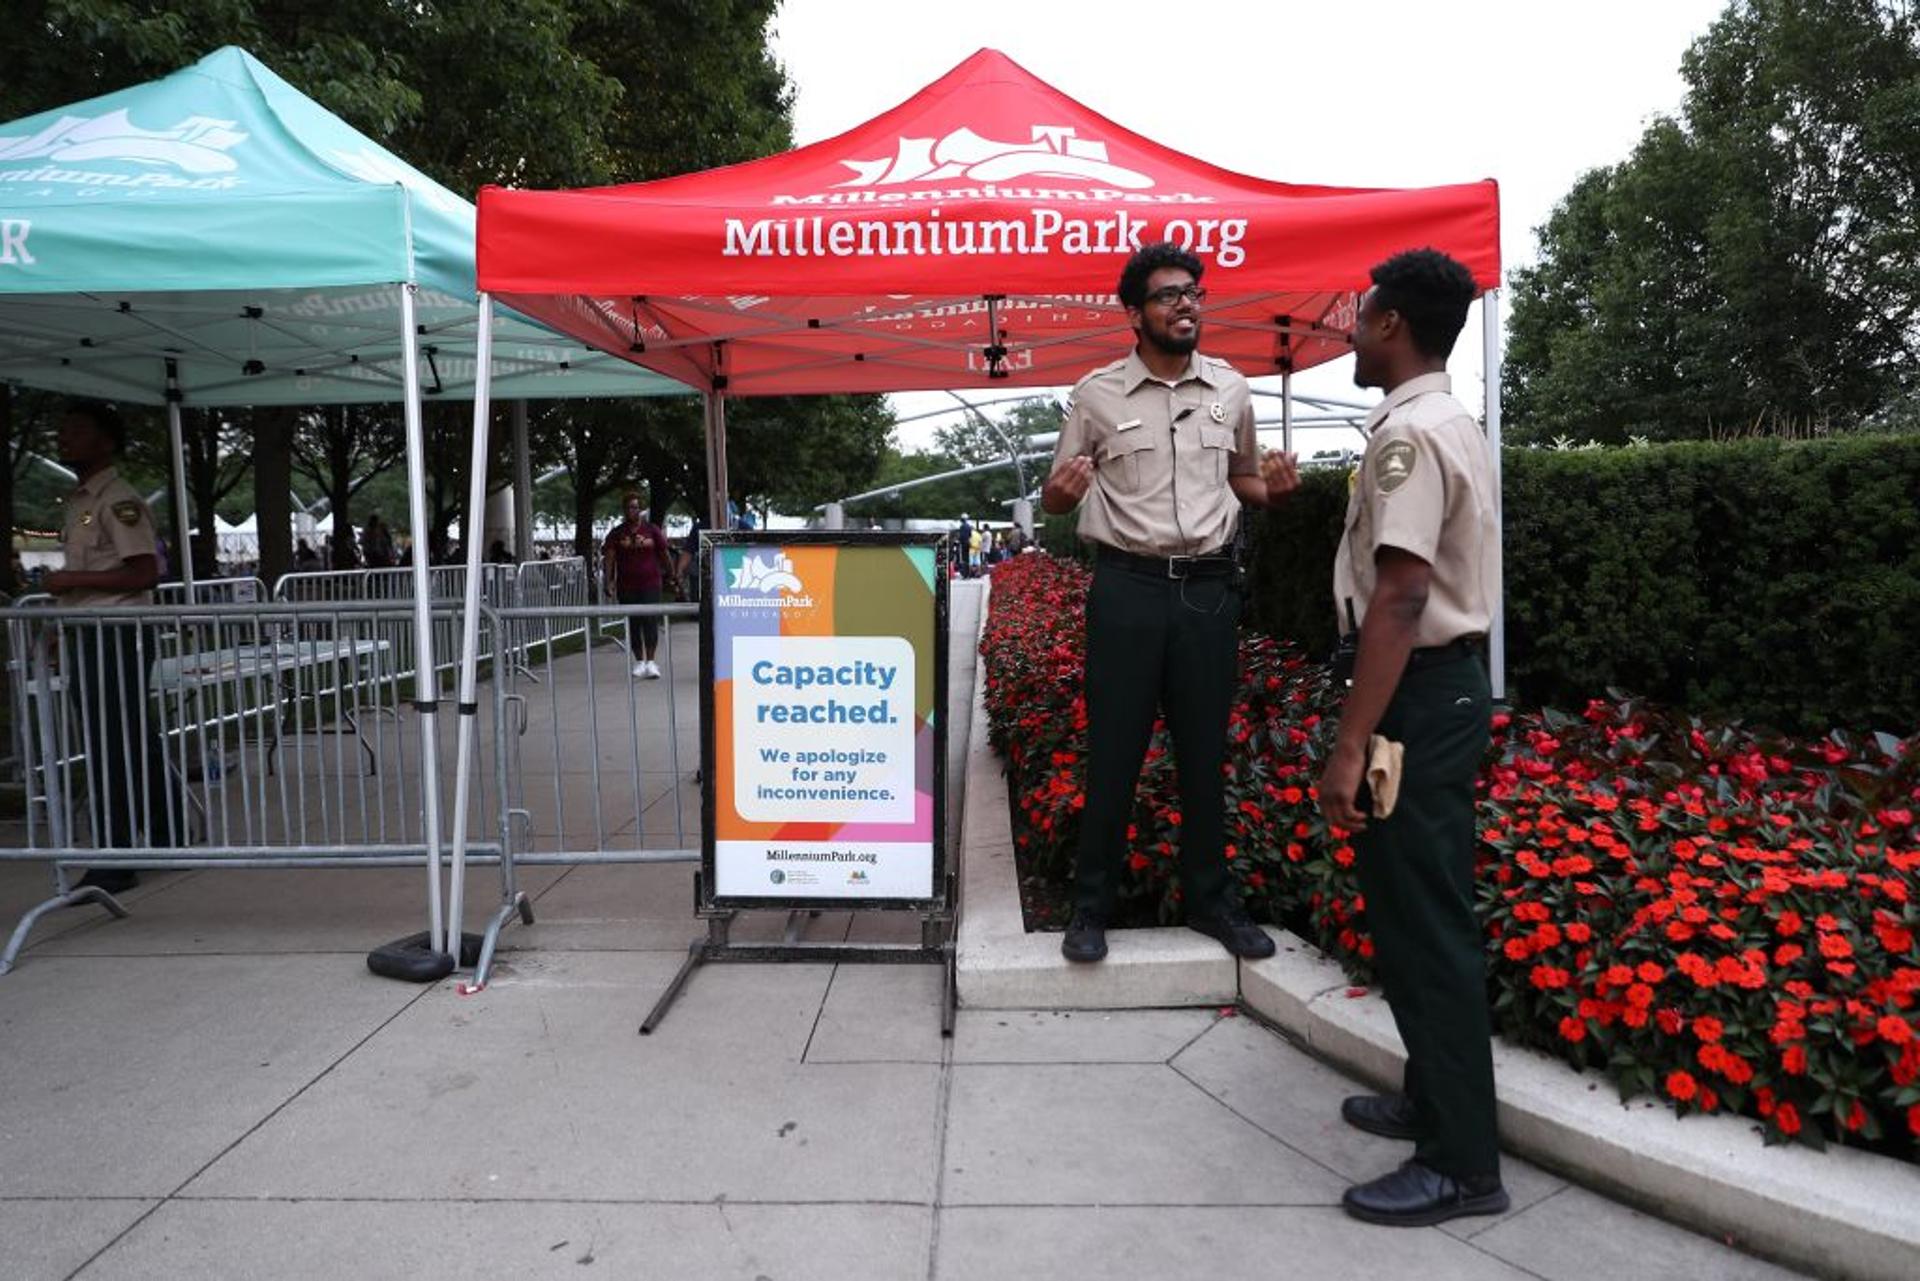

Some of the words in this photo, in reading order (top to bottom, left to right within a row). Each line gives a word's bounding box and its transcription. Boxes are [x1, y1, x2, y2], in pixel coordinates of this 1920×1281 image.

[771, 184, 1215, 205] MillenniumPark
[722, 208, 1248, 268] MillenniumParkorg
[718, 594, 813, 608] MillenniumPark
[751, 660, 897, 690] Capacity
[757, 699, 898, 724] reached.
[760, 748, 791, 763] We
[796, 748, 887, 766] apologize
[792, 767, 818, 782] for
[824, 769, 857, 784] any
[757, 785, 896, 801] inconvenience.
[766, 850, 877, 865] MillenniumPark.org
